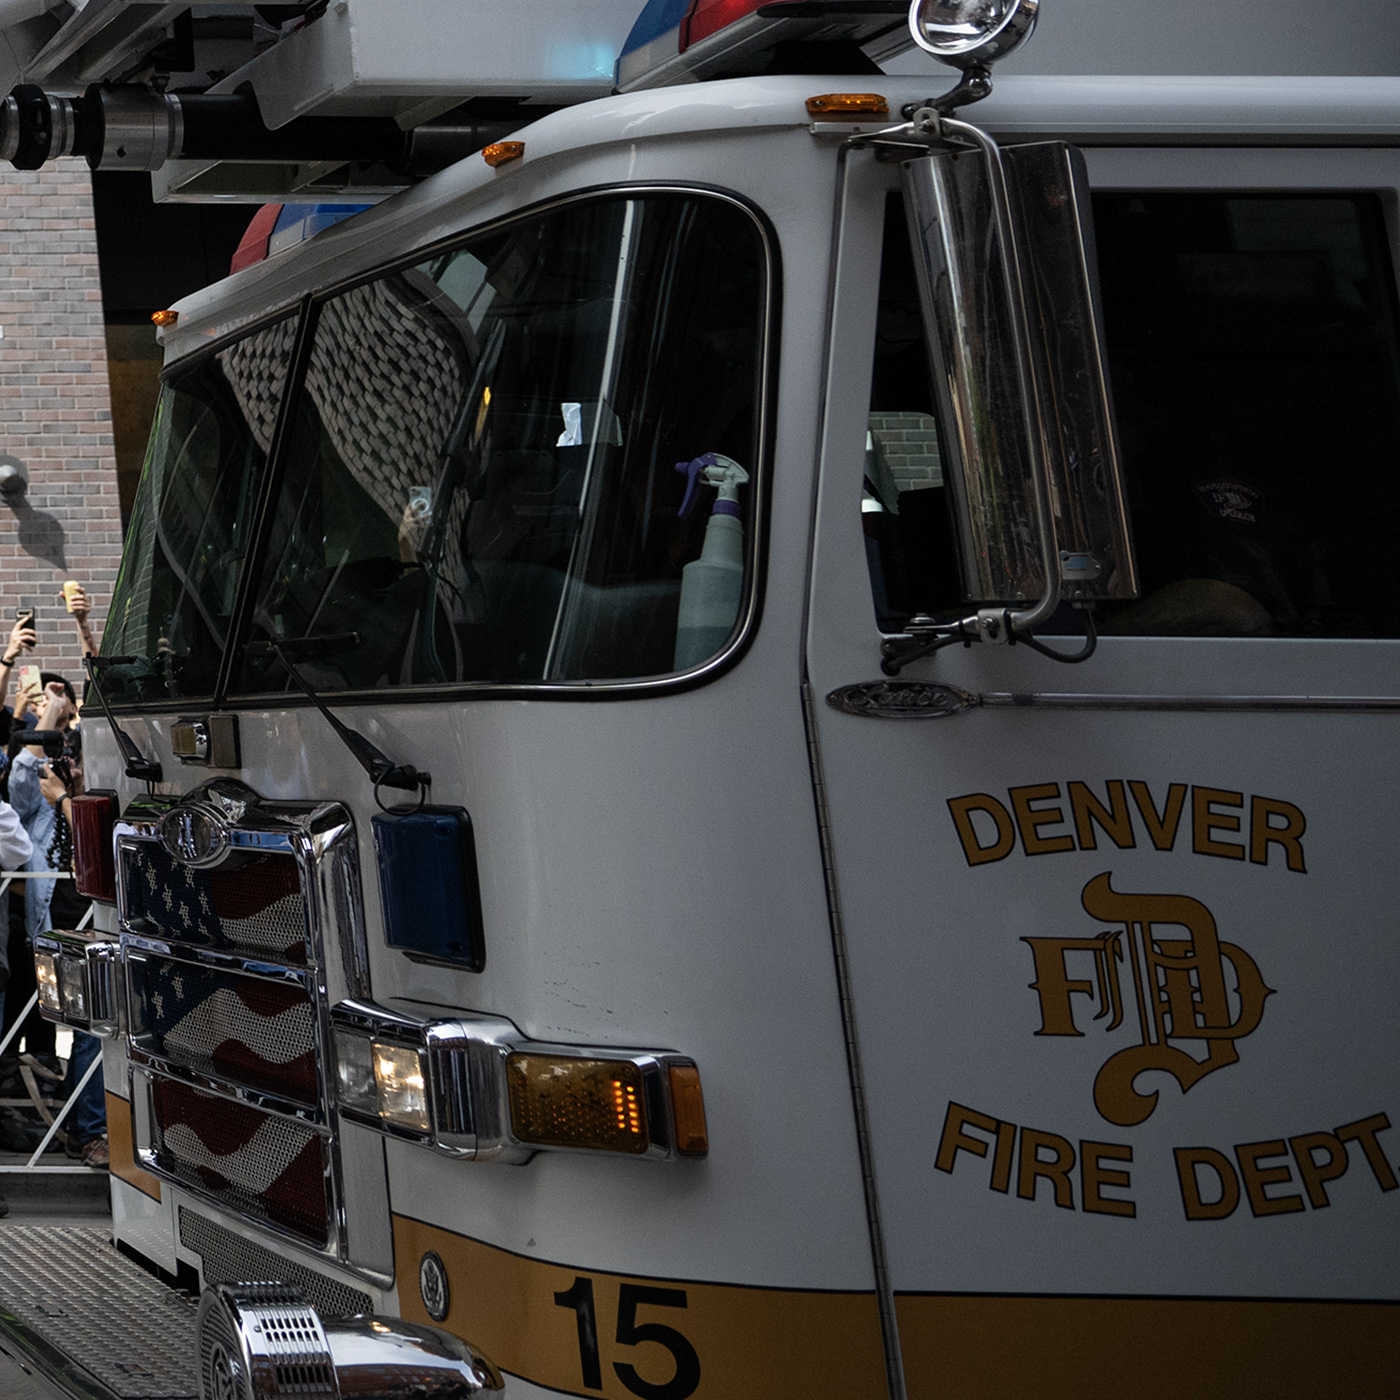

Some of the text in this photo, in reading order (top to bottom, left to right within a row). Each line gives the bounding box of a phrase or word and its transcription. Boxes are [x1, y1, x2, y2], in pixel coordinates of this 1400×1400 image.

[946, 779, 1308, 875] DENVER
[934, 1100, 1400, 1221] FIRE DEPT
[553, 1276, 701, 1400] 15
